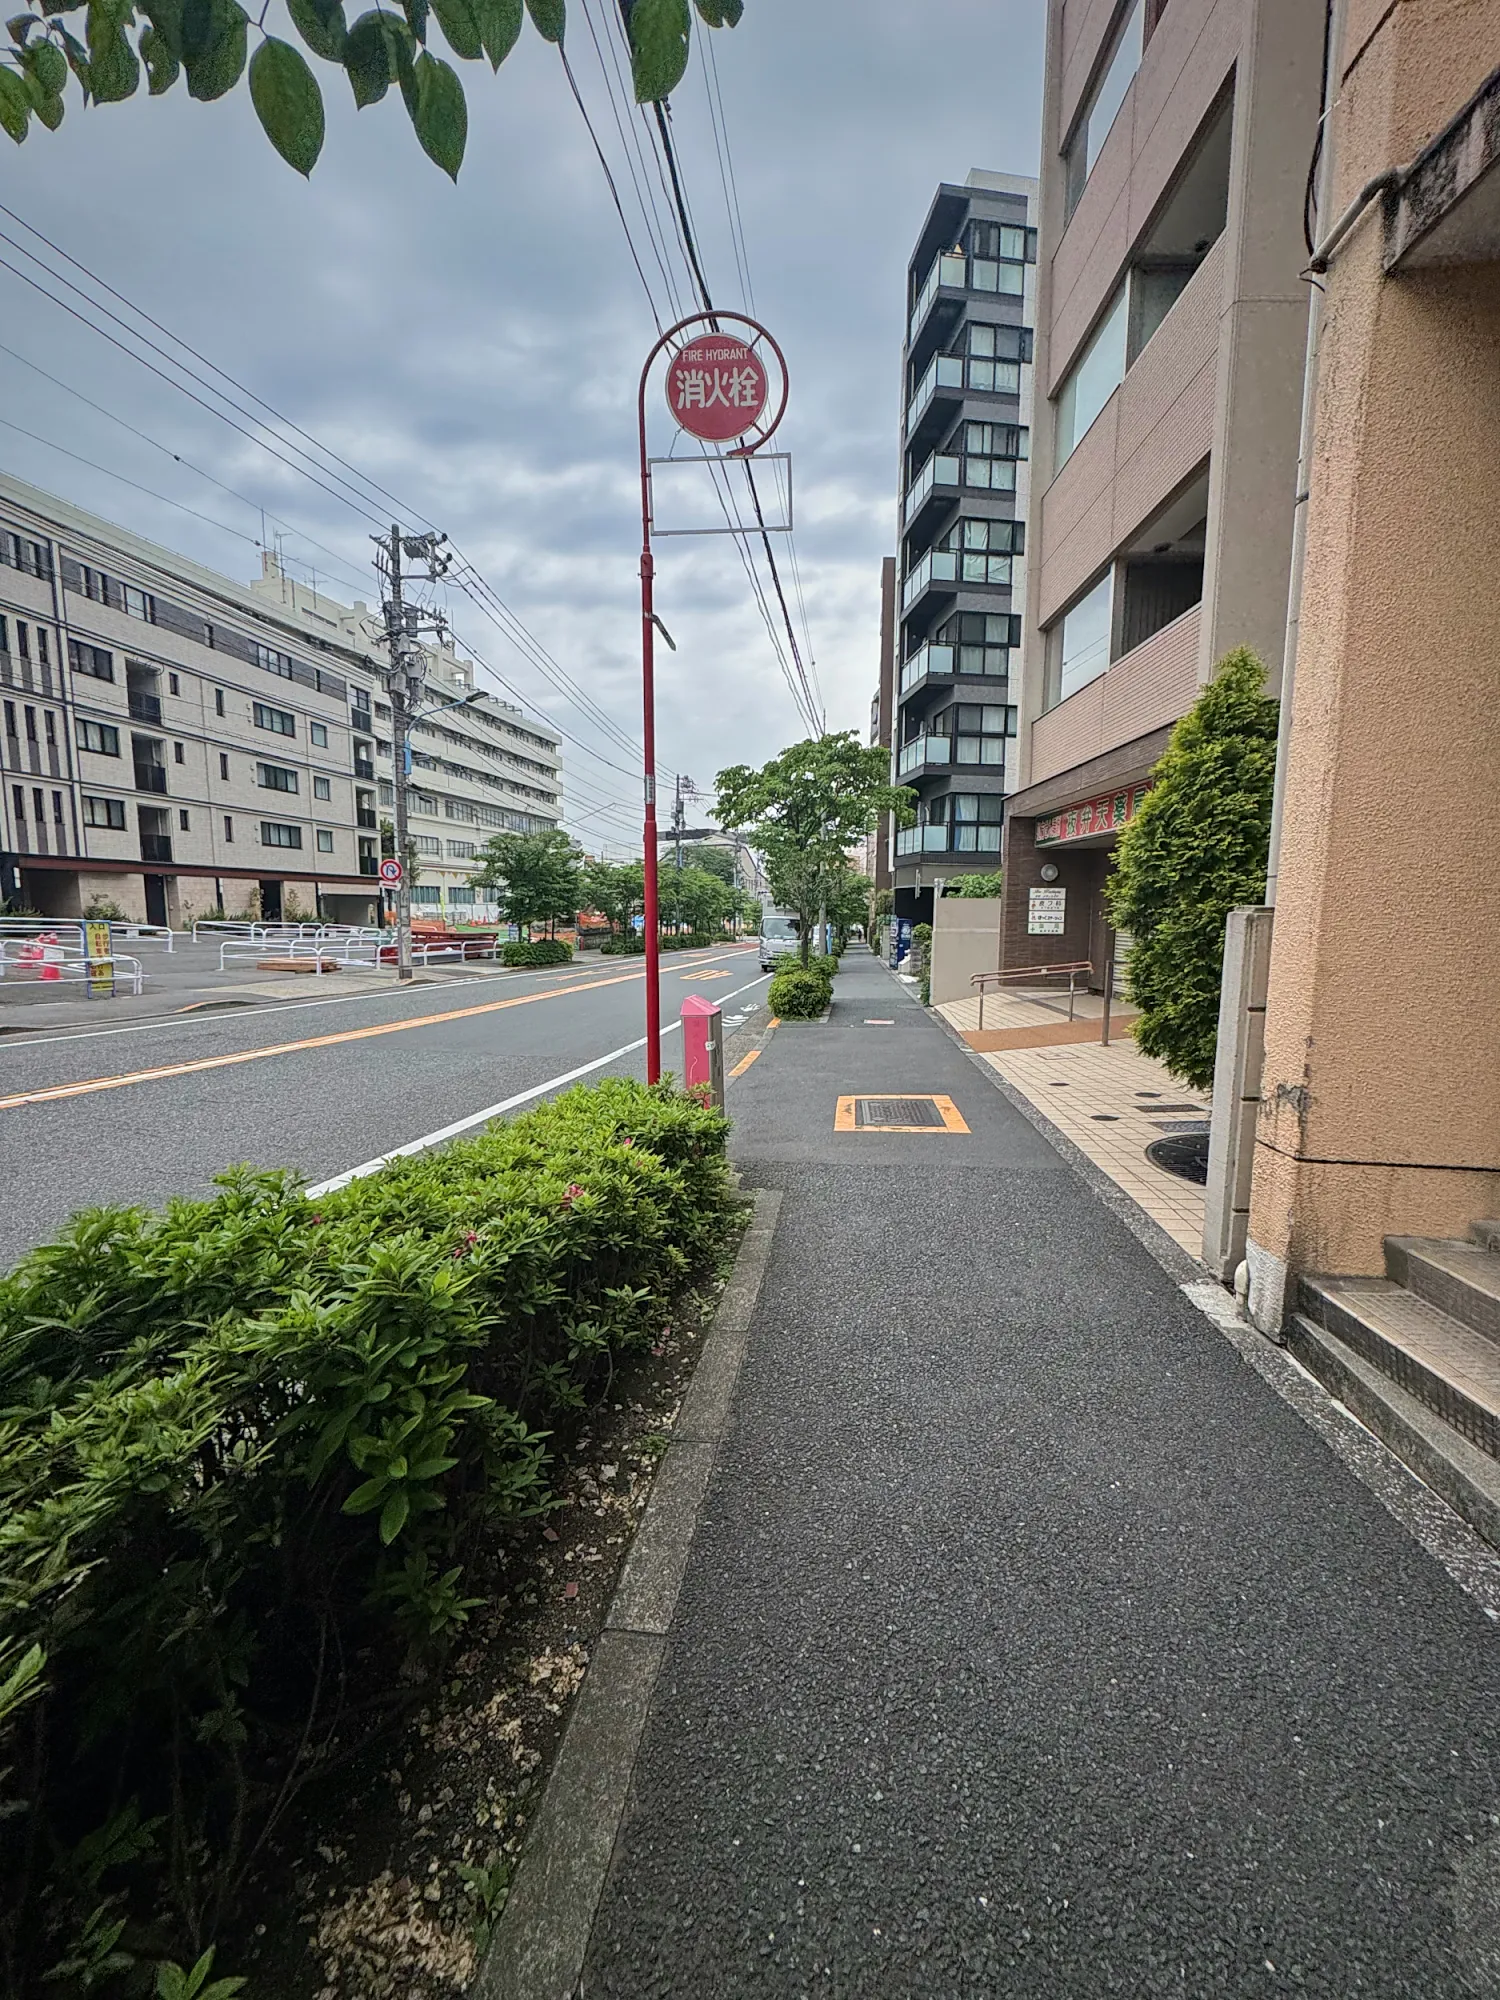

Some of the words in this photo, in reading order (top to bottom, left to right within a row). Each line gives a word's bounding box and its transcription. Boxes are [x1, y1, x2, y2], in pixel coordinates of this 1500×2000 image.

[682, 350, 703, 362] FIRE
[706, 347, 749, 361] HYDRANT
[675, 366, 759, 410] 消火栓
[89, 922, 105, 930] 入口
